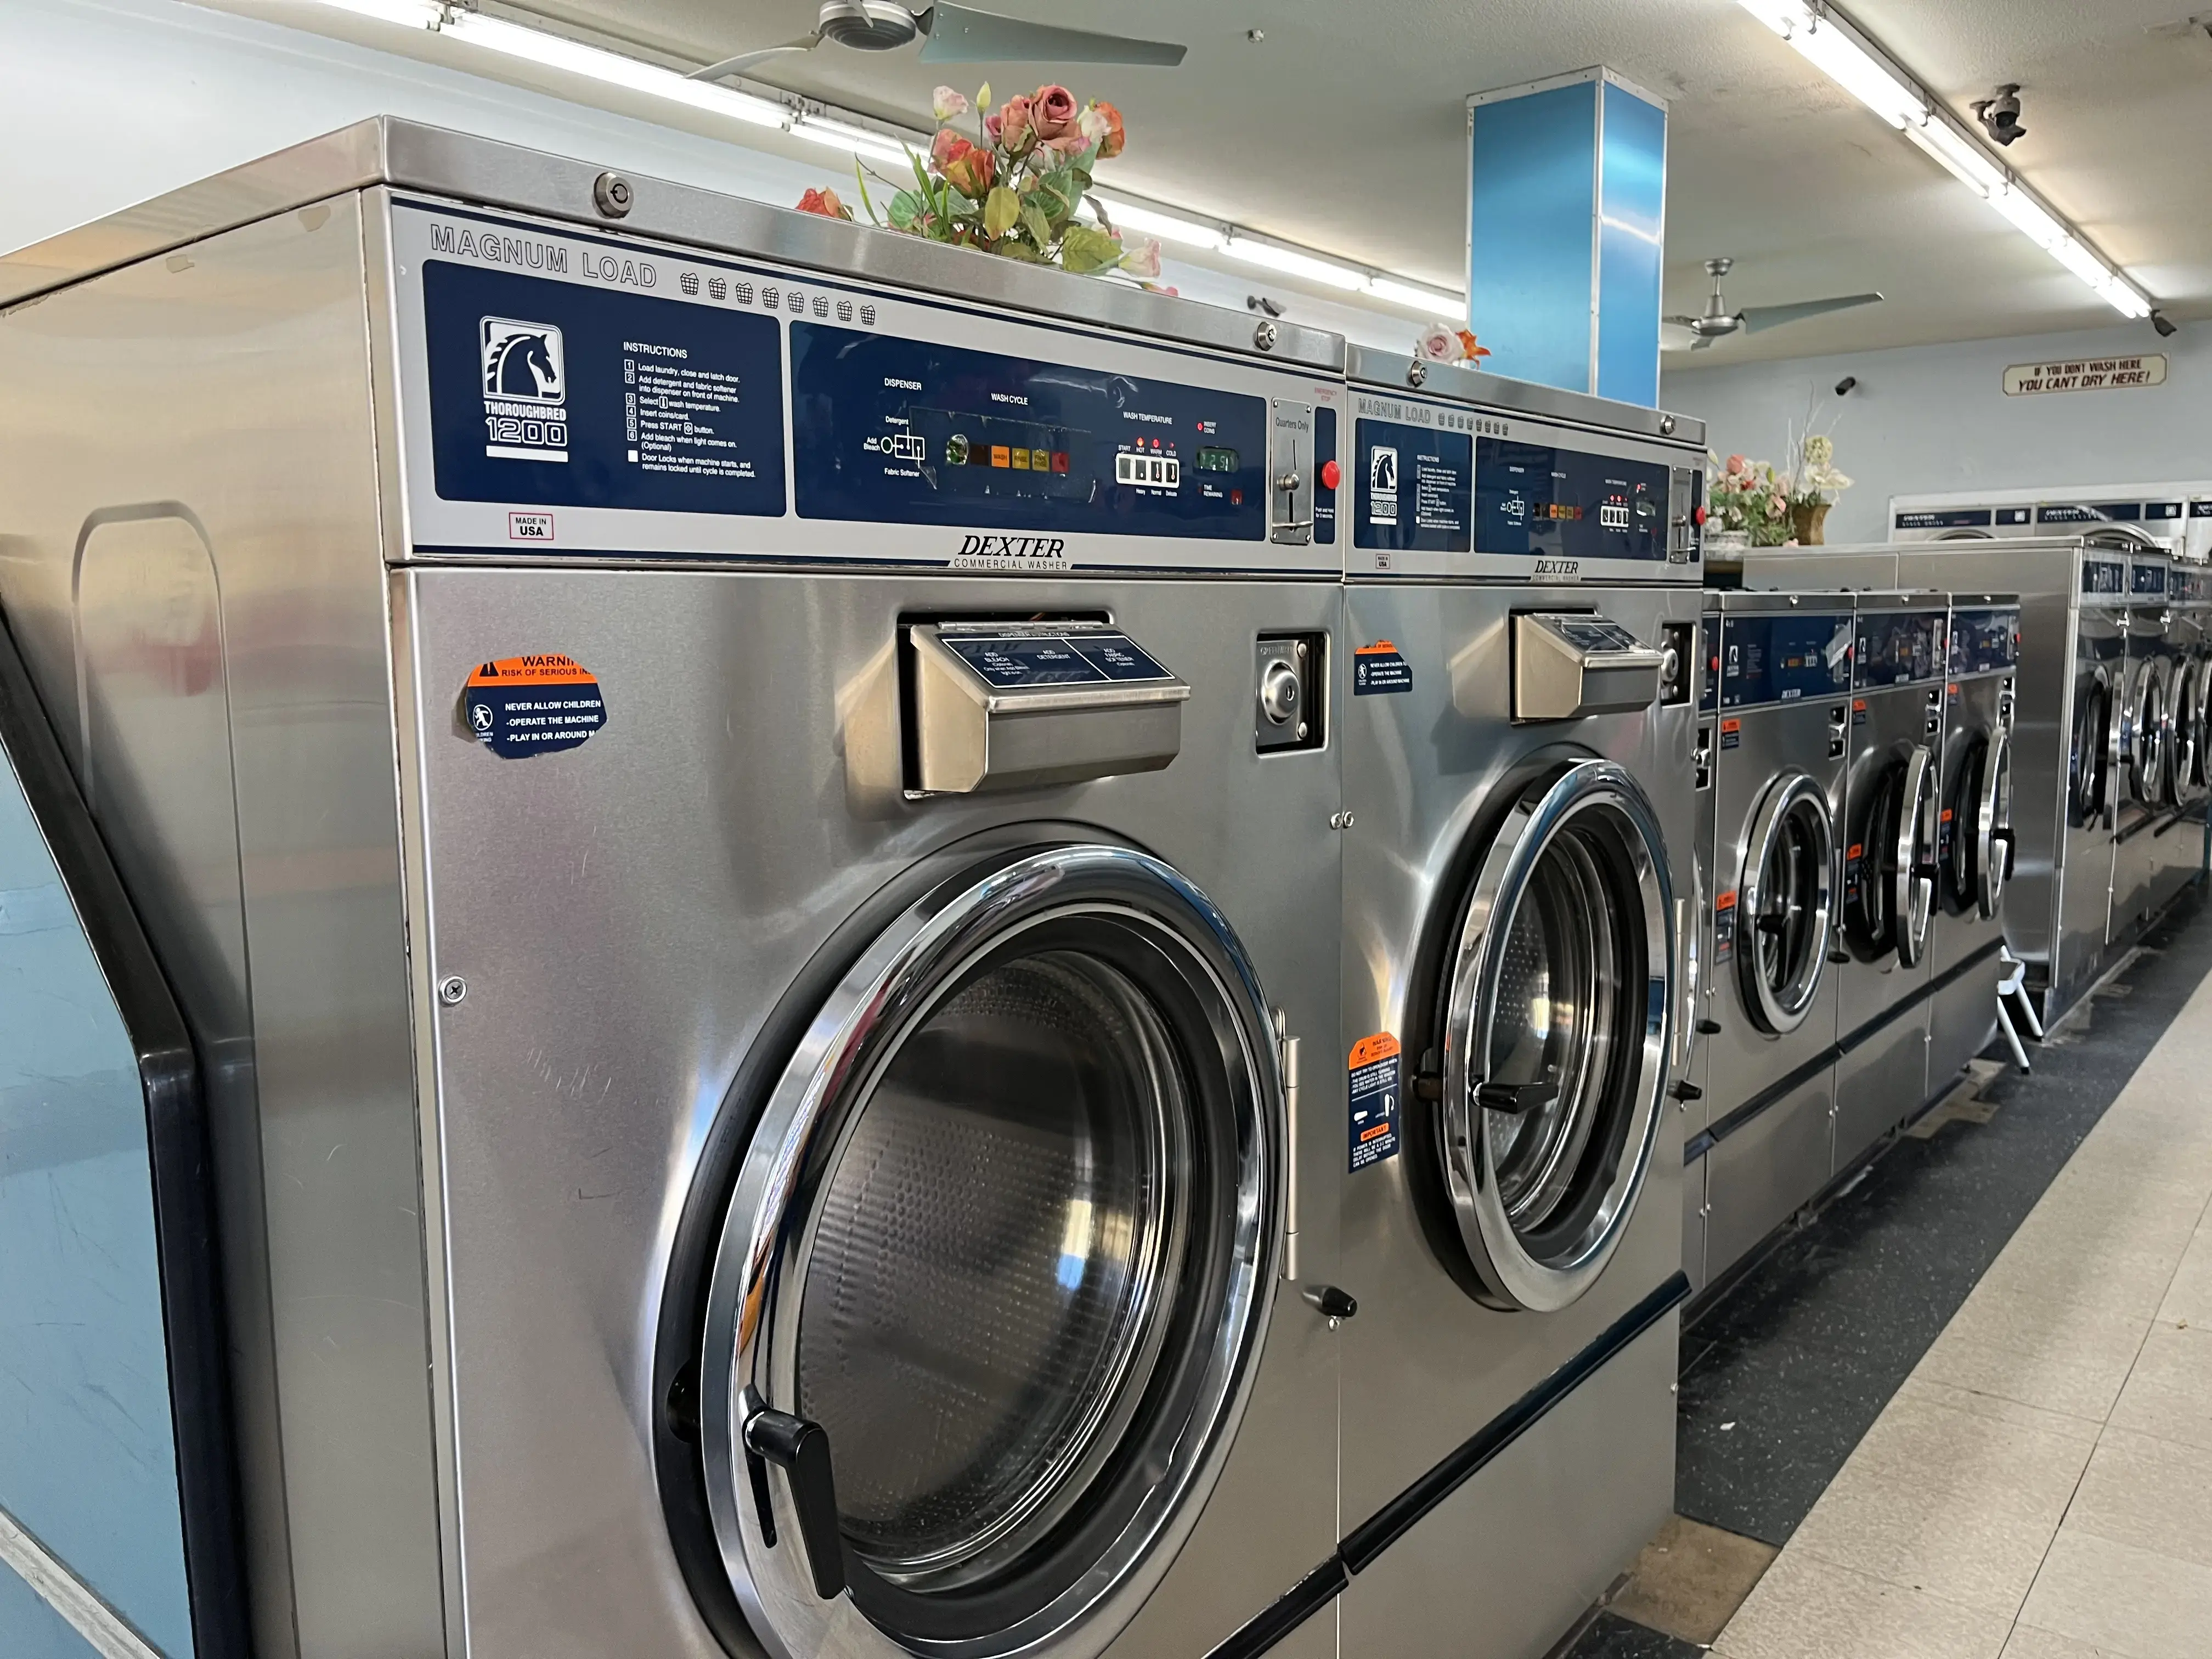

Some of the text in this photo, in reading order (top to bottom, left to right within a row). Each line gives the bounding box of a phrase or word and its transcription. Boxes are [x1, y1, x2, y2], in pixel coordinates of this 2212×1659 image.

[430, 224, 657, 288] MAGNUM LOAD
[624, 342, 687, 359] INSTRUCTIONS
[638, 363, 654, 372] Load
[656, 365, 680, 376] laundry,
[681, 369, 696, 377] close
[710, 373, 724, 381] latch
[726, 374, 740, 383] door.
[2047, 365, 2061, 376] YOU
[2090, 362, 2116, 373] WASH
[2119, 359, 2141, 370] HERE
[639, 375, 651, 383] Add
[653, 377, 681, 388] detergent
[696, 382, 712, 390] fabric
[713, 385, 736, 393] softener
[884, 378, 922, 390] DISPENSER
[2019, 378, 2041, 392] YOU
[2081, 374, 2107, 387] DRY
[2111, 371, 2149, 384] HERE!
[652, 386, 681, 396] dispenser
[692, 389, 706, 398] front
[707, 391, 713, 399] of
[714, 393, 740, 403] machine.
[991, 393, 1028, 405] WASH CYCLE
[484, 401, 566, 421] THOROUGHBRED
[640, 396, 658, 405] Select
[685, 401, 721, 412] temperature.
[1358, 398, 1431, 424] MAGNUM LOAD
[640, 408, 657, 417] Insert
[658, 410, 690, 420] coins/card.
[885, 416, 909, 425] Detergent
[1123, 411, 1172, 425] WASH TEMPERATURE
[486, 416, 567, 446] 1200
[641, 420, 658, 429] Press
[660, 422, 682, 431] START
[695, 426, 714, 434] button.
[1276, 417, 1308, 433] Quarters Only
[655, 433, 675, 442] bleach
[694, 437, 707, 446] light
[641, 442, 672, 452] (Optional)
[864, 443, 880, 451] Bleach
[659, 454, 676, 463] Locks
[696, 458, 720, 466] machine
[642, 462, 667, 471] remains
[668, 464, 687, 472] locked
[703, 467, 718, 475] cycle
[725, 469, 755, 478] completed.
[1370, 501, 1397, 516] 1200
[516, 517, 536, 526] MADE
[520, 526, 543, 536] USA
[958, 535, 1064, 558] DEXTER
[955, 558, 1066, 569] COMMERCIAL WASHER
[1535, 561, 1578, 573] DEXTER
[505, 703, 532, 711] NEVER
[563, 700, 601, 709] CHILDREN
[506, 718, 546, 726] -OPERATE
[565, 715, 599, 724] MACHINE
[507, 733, 531, 742] -PLAY
[555, 731, 587, 739] AROUND
